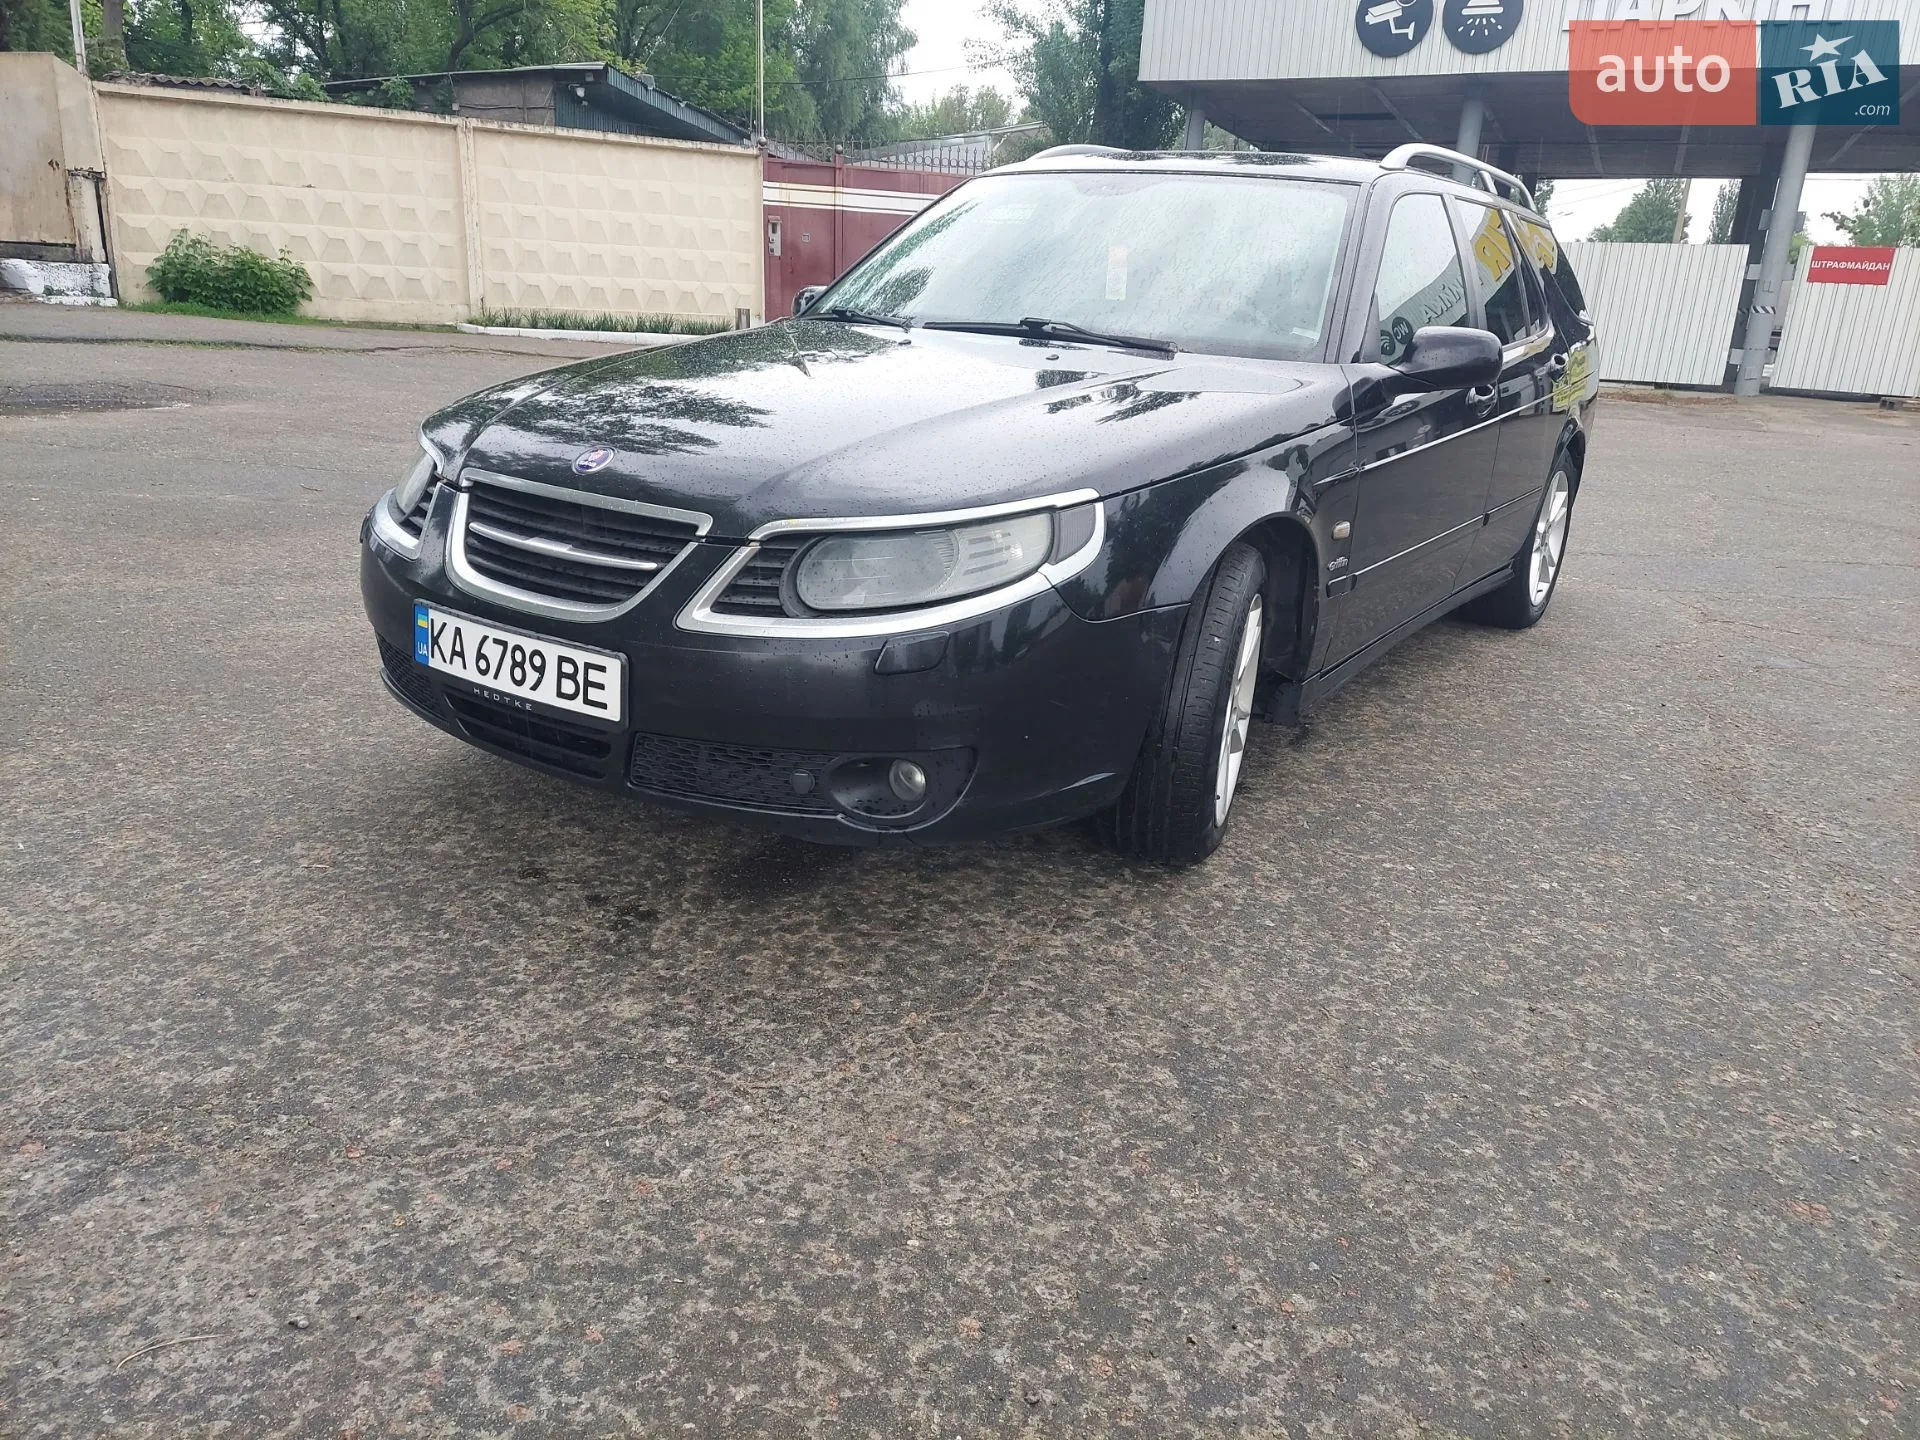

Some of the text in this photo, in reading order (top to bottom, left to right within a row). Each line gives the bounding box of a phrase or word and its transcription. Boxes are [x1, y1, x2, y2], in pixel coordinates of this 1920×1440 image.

[1811, 260, 1890, 271] ШТРАФМАЙДАН
[417, 640, 428, 657] UA
[430, 618, 608, 710] KA 6789 BE
[473, 687, 533, 711] HEDTKE
